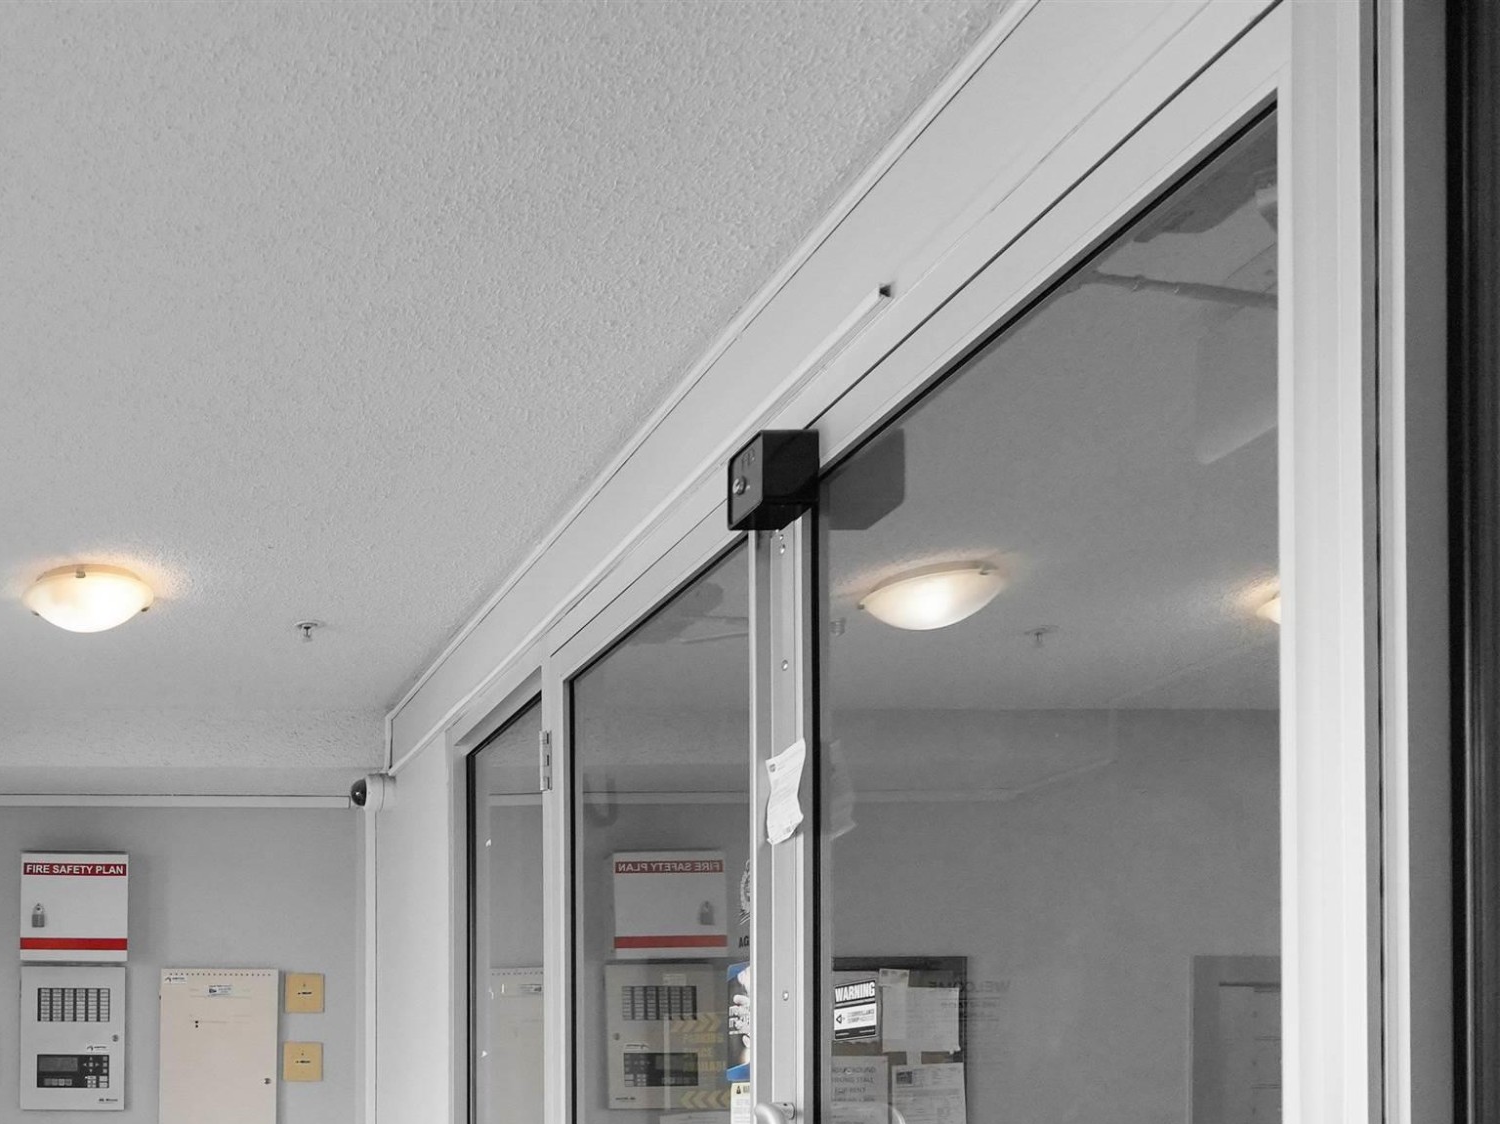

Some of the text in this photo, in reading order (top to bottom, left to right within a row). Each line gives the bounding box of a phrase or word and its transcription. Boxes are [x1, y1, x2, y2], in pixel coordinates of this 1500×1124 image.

[26, 864, 124, 875] FIRE SAFETY PLAN
[834, 981, 875, 1003] WARNING
